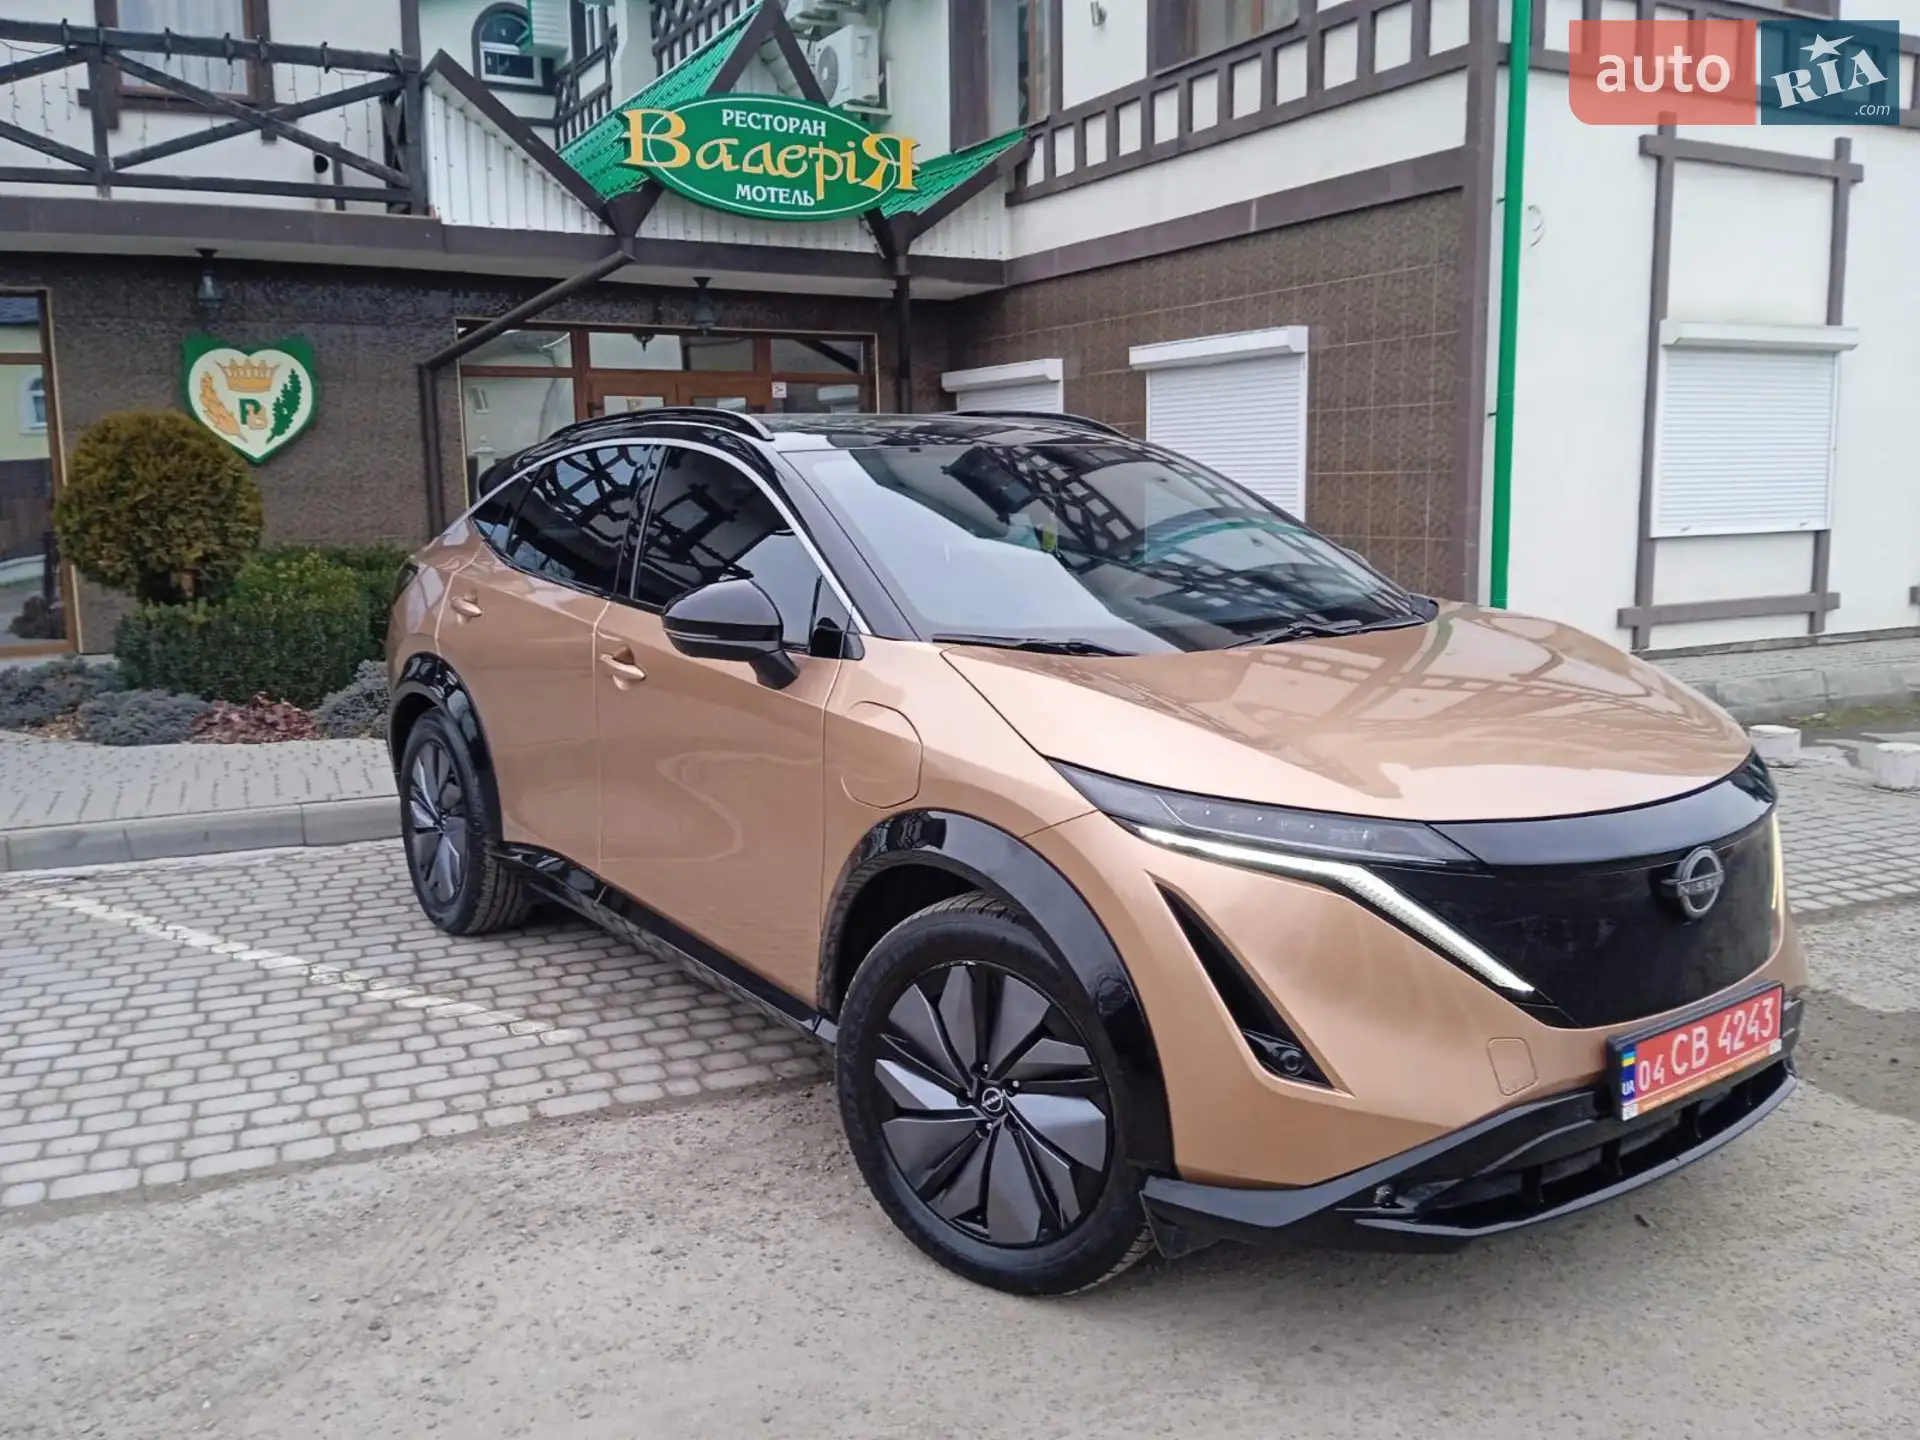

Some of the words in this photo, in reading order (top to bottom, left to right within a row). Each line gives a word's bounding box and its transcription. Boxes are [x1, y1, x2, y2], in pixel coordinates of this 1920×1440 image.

[721, 108, 827, 138] РЕСТОРАН
[735, 184, 815, 207] МОТЕЛЬ
[1677, 875, 1724, 897] NISS
[1638, 1053, 1665, 1092] 04
[1671, 1025, 1710, 1076] CB
[1717, 996, 1775, 1055] 4243
[1622, 1079, 1635, 1096] UA
